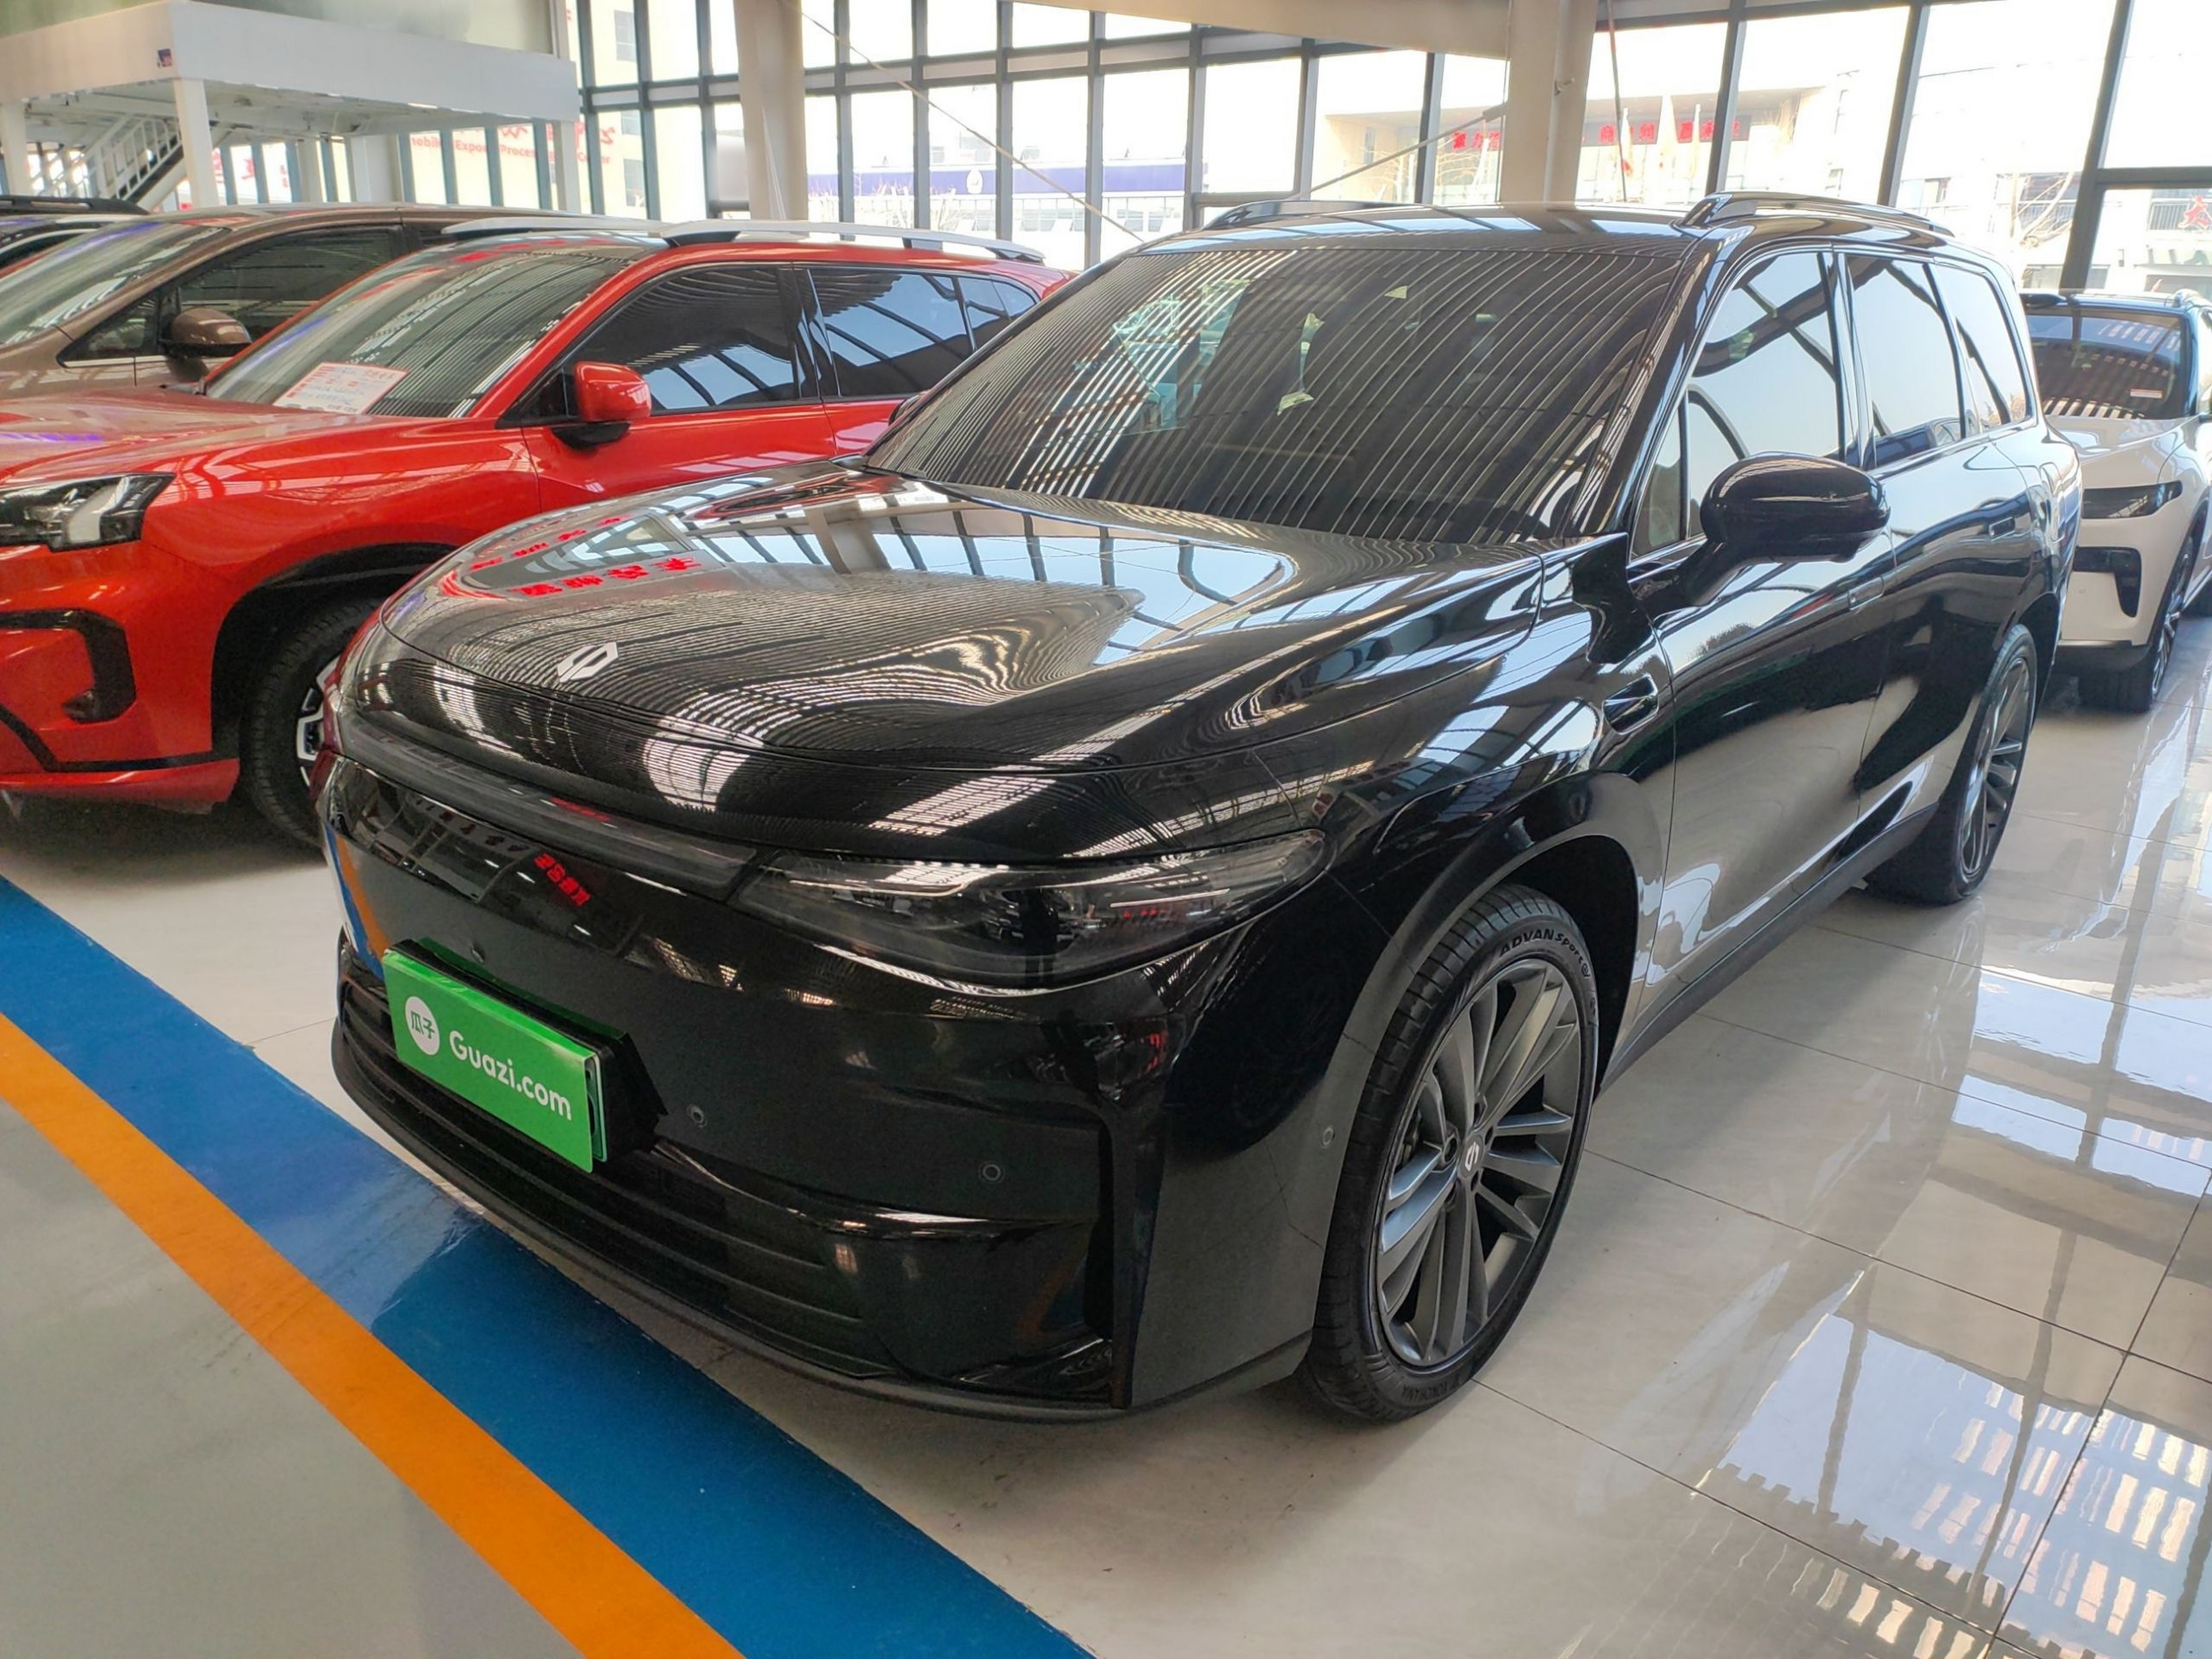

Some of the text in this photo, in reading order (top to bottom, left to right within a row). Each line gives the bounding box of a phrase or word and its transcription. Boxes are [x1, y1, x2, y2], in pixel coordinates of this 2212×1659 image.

[1499, 928, 1554, 957] ADVAN
[410, 1010, 436, 1039] 瓜子
[449, 1030, 571, 1120] Guazi.com
